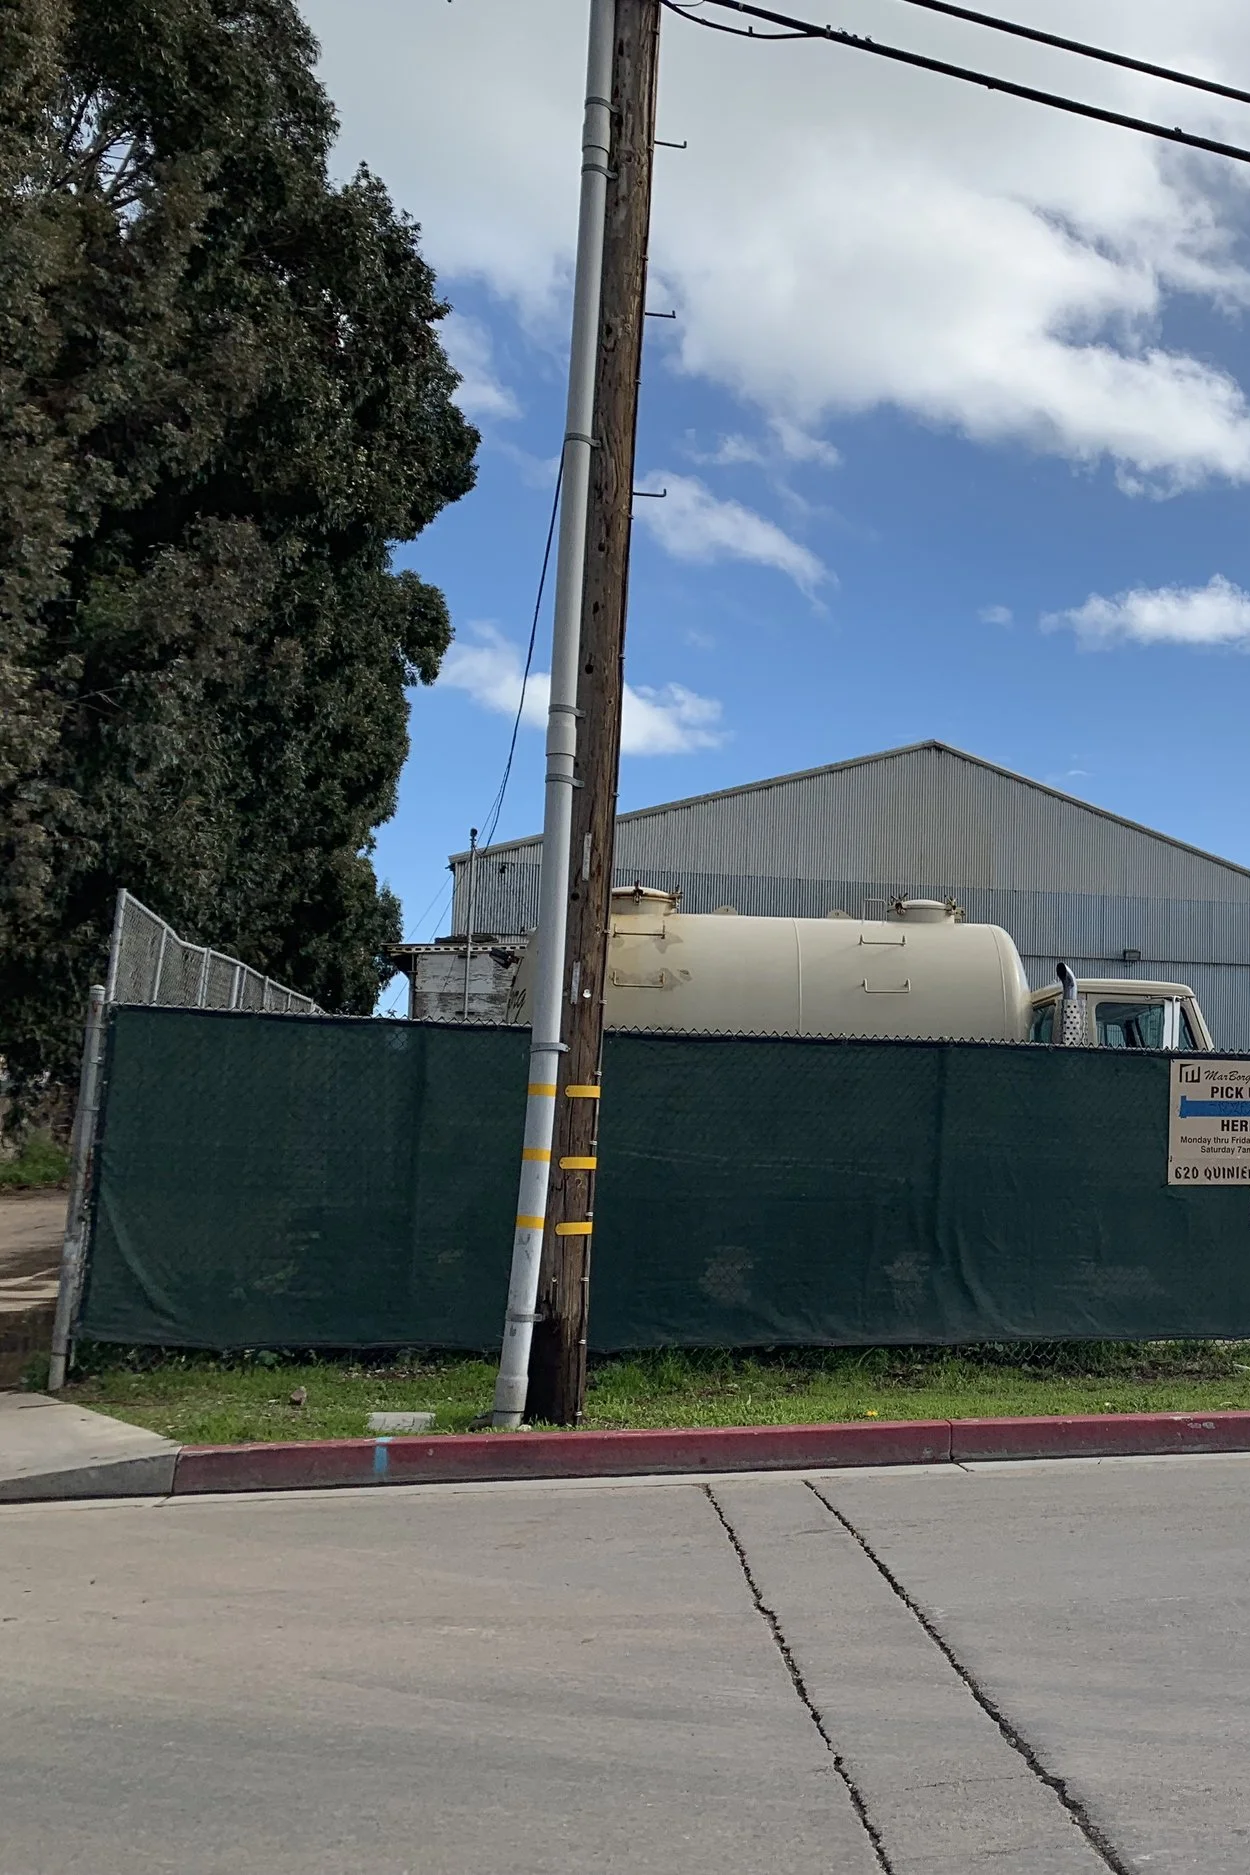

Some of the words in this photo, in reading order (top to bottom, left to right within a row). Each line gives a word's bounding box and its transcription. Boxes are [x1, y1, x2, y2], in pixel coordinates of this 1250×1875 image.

[1211, 1086, 1244, 1099] PICK
[1180, 1136, 1212, 1146] Monday
[1213, 1136, 1230, 1144] thru
[1200, 1145, 1235, 1156] Saturday
[1174, 1166, 1199, 1179] 620
